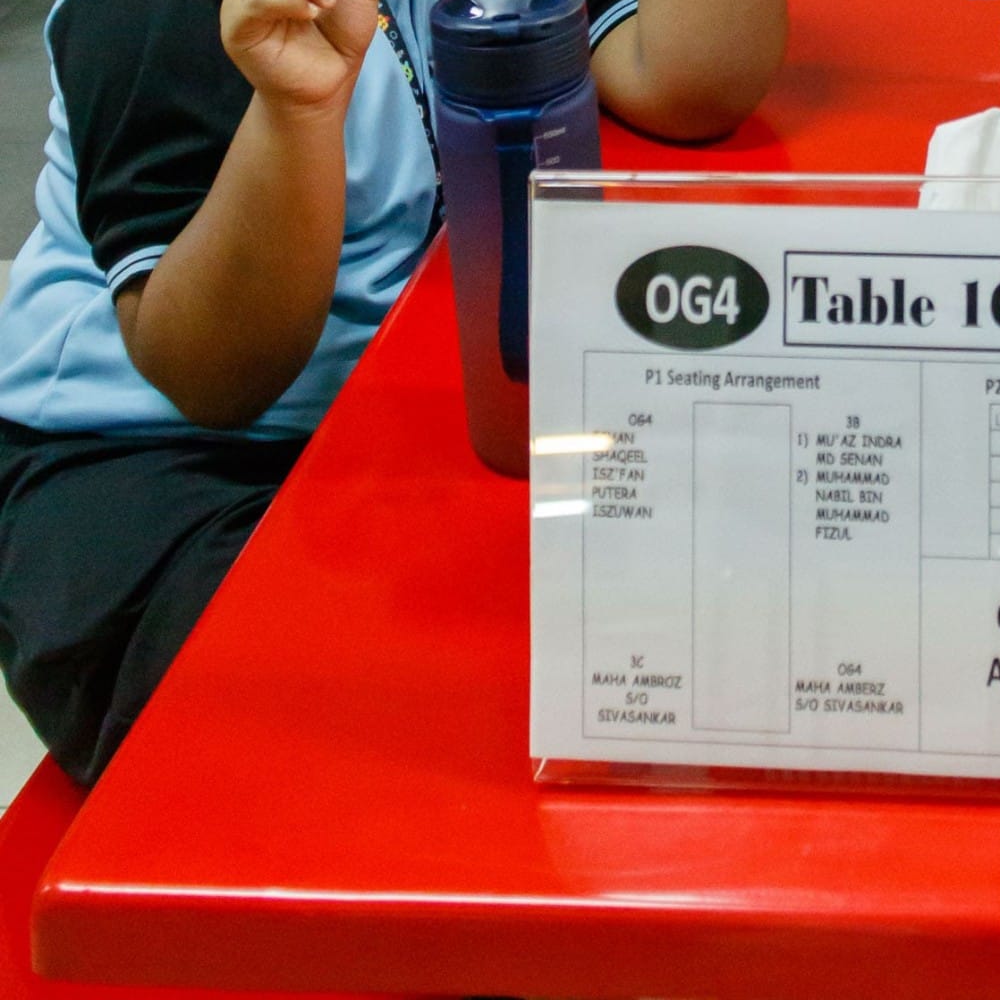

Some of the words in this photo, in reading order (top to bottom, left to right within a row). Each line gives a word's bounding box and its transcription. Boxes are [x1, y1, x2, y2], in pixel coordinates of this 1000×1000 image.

[645, 273, 740, 326] OG4
[791, 276, 936, 328] Table
[645, 369, 664, 385] P1
[668, 370, 720, 390] Seating
[724, 372, 820, 393] Arrangement
[628, 414, 653, 427] OG4
[797, 433, 808, 448] 1)
[861, 435, 902, 448] INDRA
[593, 450, 648, 464] SHAQEEL
[816, 453, 835, 465] MD
[840, 453, 883, 466] SENAN
[797, 470, 808, 486] 2)
[816, 471, 890, 485] MUHAMMAD
[592, 486, 637, 500] PUTERA
[815, 489, 854, 503] NABIL
[860, 491, 883, 503] BIN
[593, 504, 652, 518] ISZUWAN
[816, 508, 890, 522] MUHAMMAD
[815, 526, 852, 540] FIZUL
[630, 656, 644, 668] 3C
[837, 663, 862, 676] OG4
[592, 672, 626, 686] MAHA
[631, 674, 682, 689] AMBROZ
[795, 680, 830, 695] MAHA
[836, 682, 885, 696] AMBERZ
[625, 692, 648, 706] S/O
[795, 698, 818, 712] S/O
[823, 700, 903, 715] SIVASANKAR
[597, 709, 676, 725] SIVASANKAR
